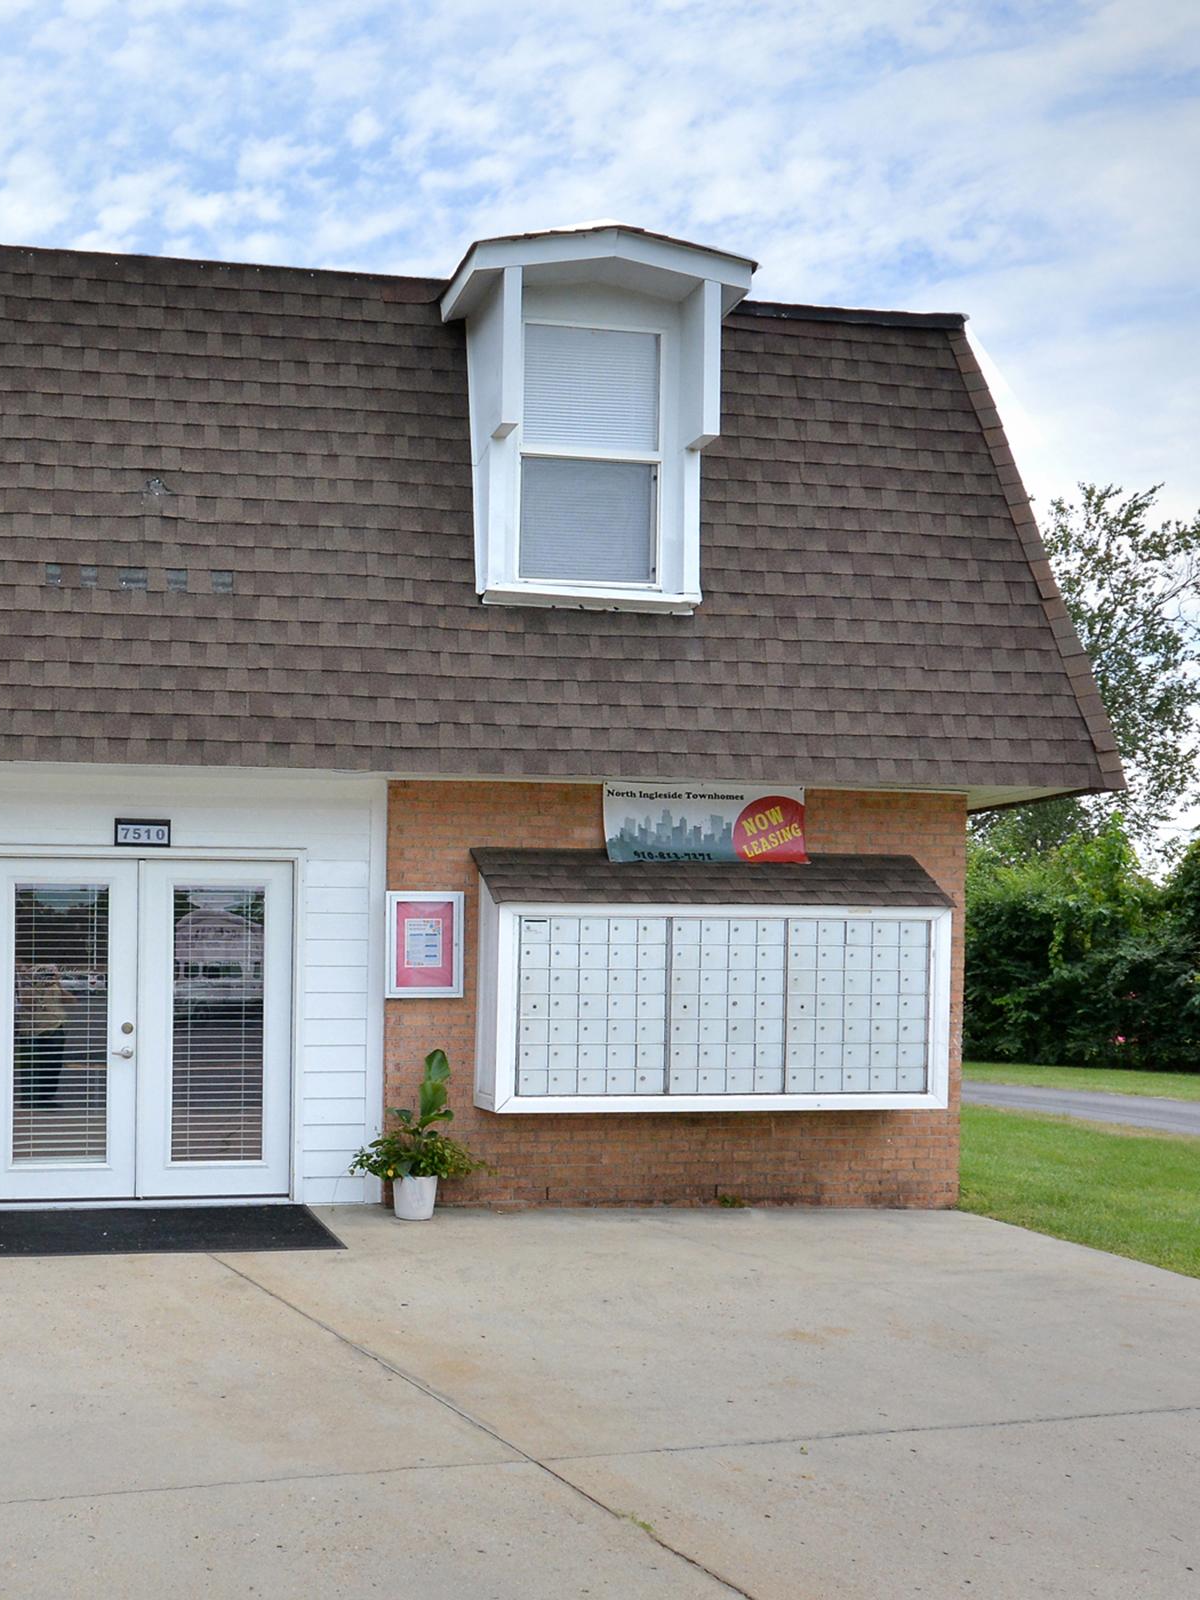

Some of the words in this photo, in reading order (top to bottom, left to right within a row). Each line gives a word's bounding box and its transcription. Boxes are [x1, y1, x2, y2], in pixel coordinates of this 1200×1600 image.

[606, 789, 636, 798] North
[638, 790, 682, 800] Ingleside
[686, 792, 744, 800] Townhomes
[741, 806, 784, 837] NOW
[121, 827, 165, 840] 7510
[742, 823, 802, 858] LEASING
